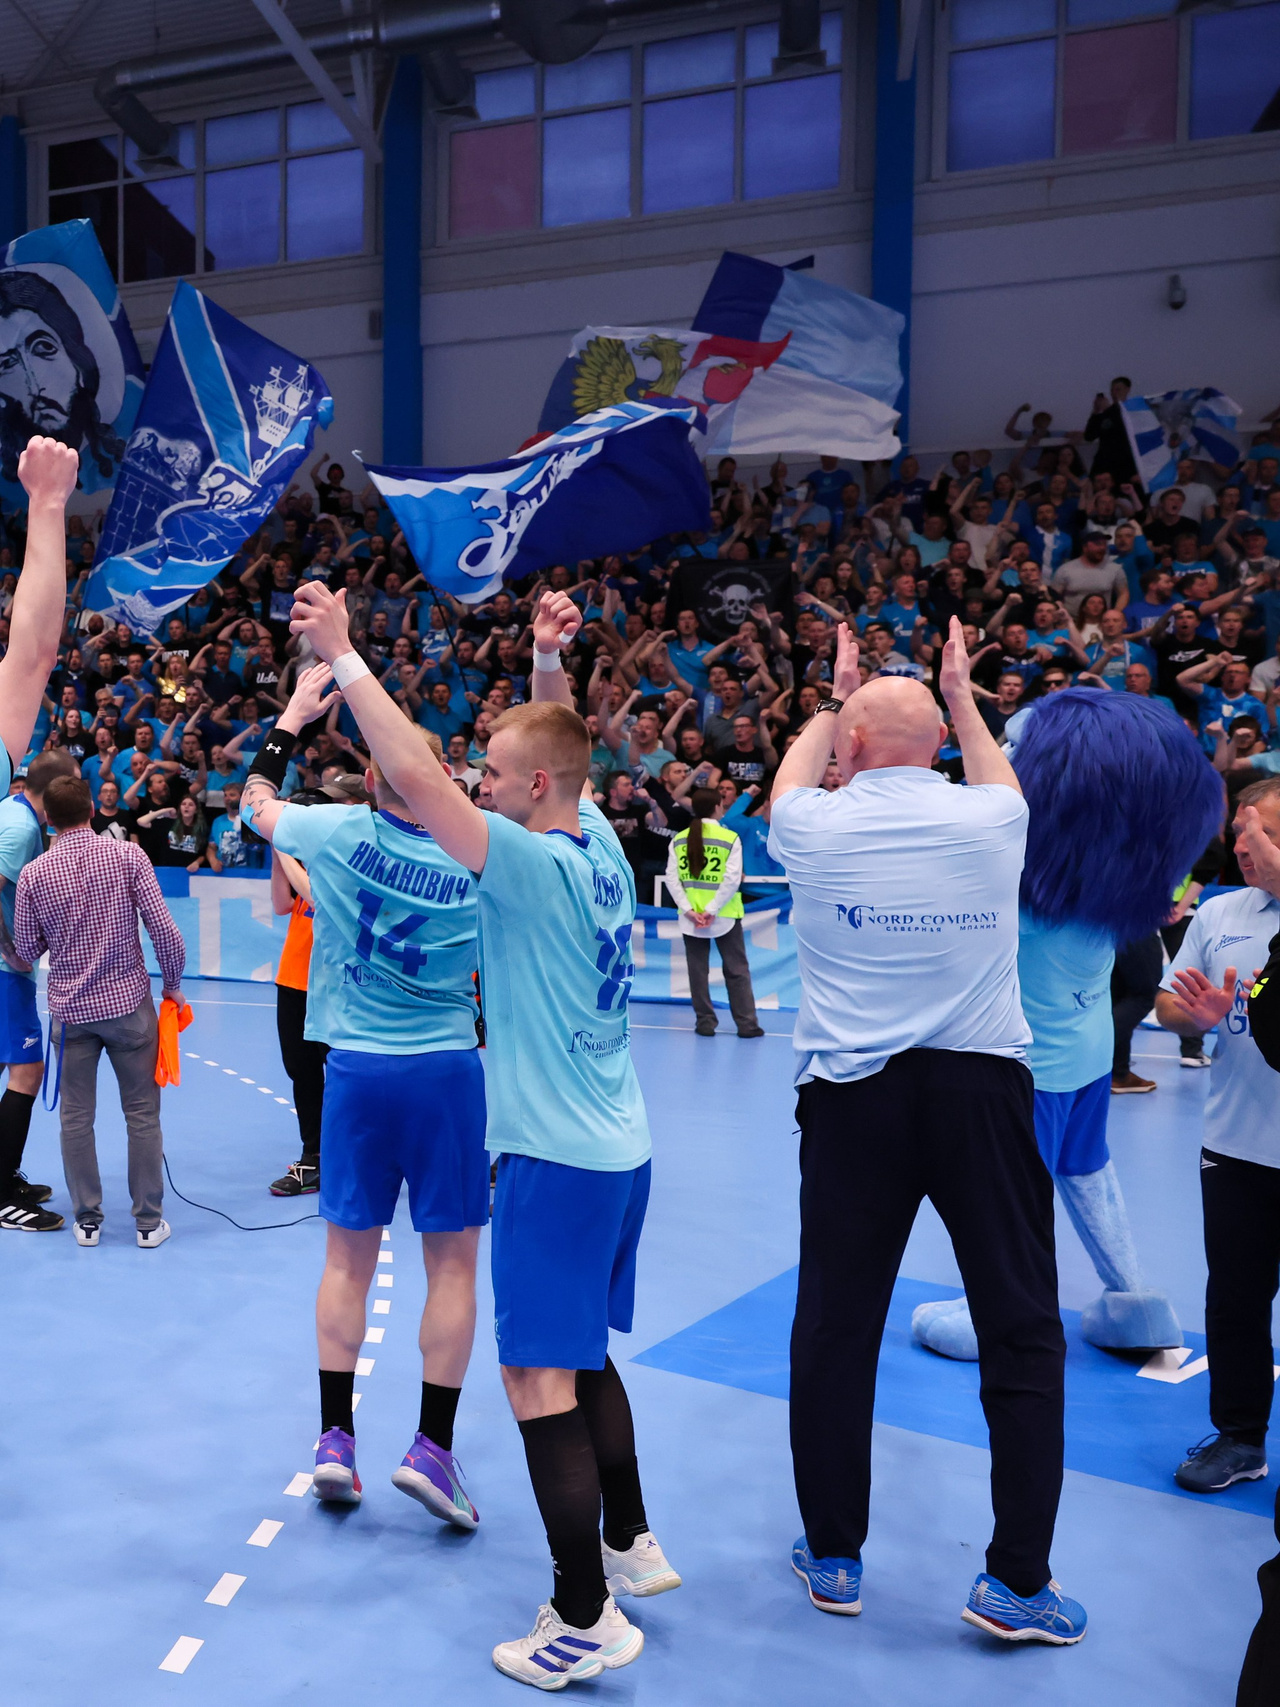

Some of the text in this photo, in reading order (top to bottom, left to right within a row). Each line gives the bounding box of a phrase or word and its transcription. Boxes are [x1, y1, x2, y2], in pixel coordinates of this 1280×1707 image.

[682, 845, 719, 854] СРД
[347, 839, 470, 906] НИКАНОВИЧ
[681, 873, 718, 883] STEARD
[868, 914, 914, 925] NORD
[920, 912, 1000, 925] COMPANY
[355, 888, 430, 977] 14
[960, 923, 997, 932] МПАНИЯ
[363, 973, 394, 986] NOR
